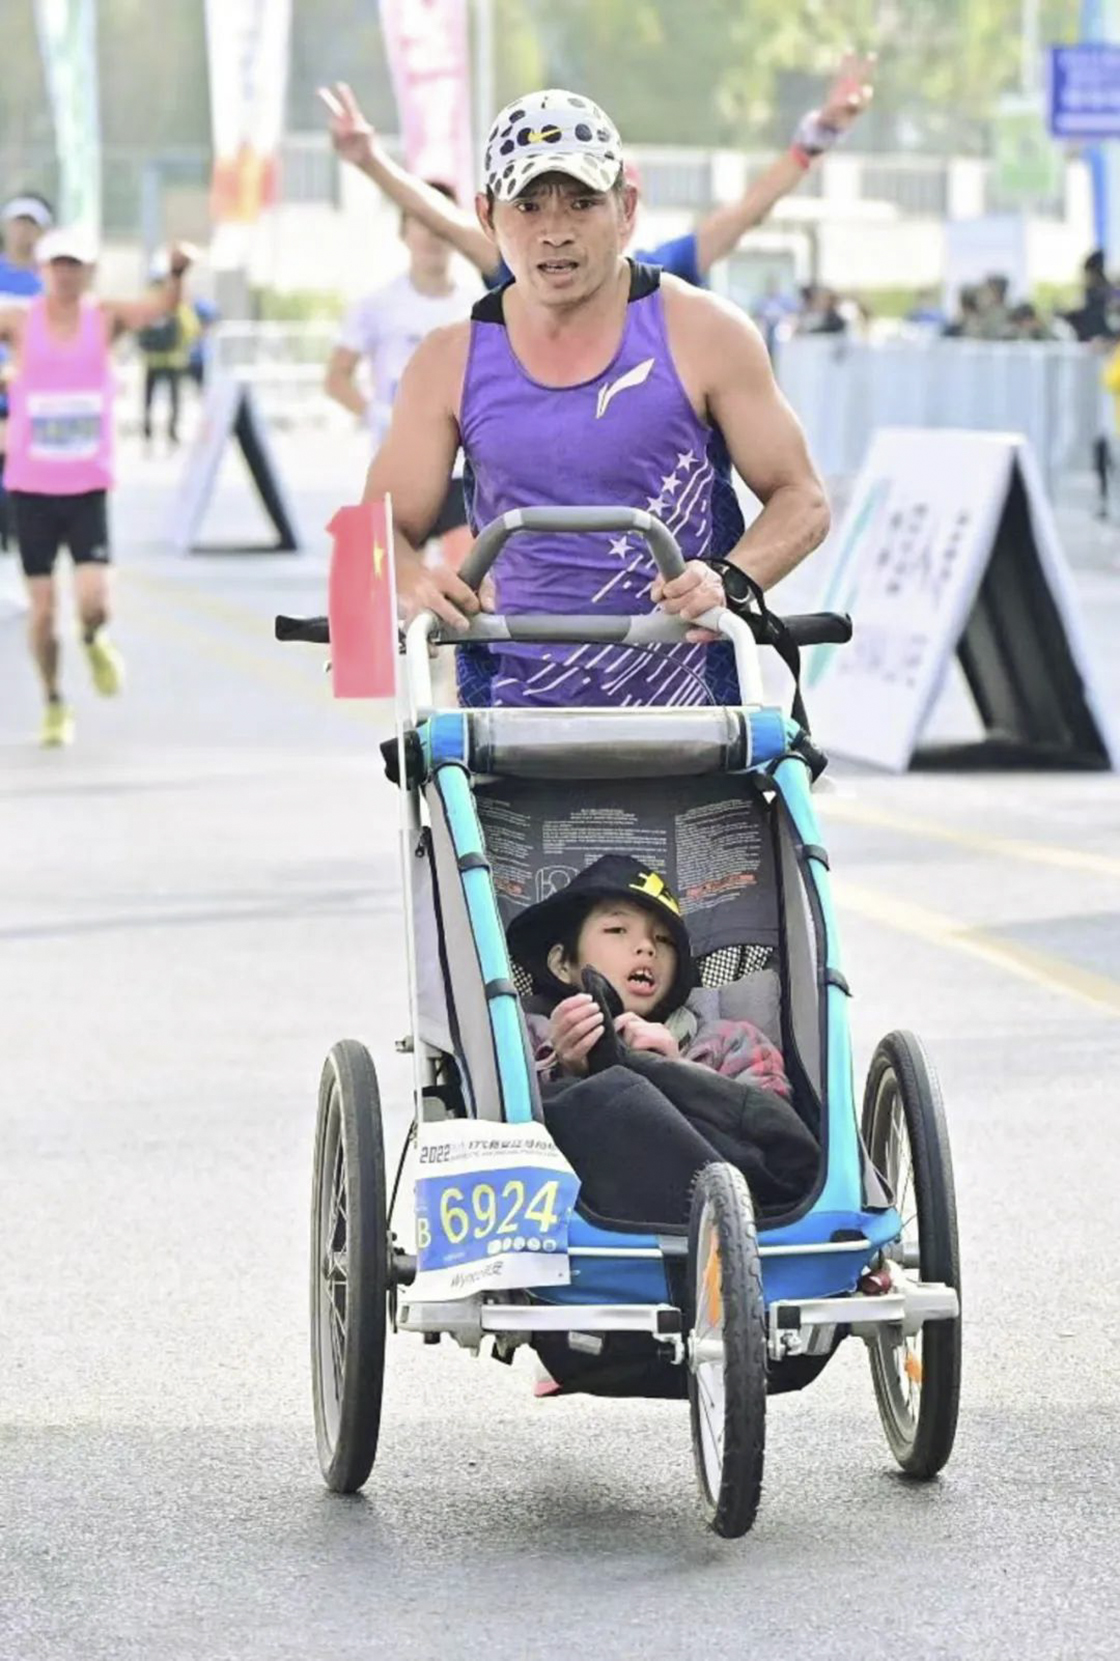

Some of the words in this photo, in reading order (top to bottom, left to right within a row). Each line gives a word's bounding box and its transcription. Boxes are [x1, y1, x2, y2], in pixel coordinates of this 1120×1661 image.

[419, 1144, 450, 1163] 2022
[440, 1180, 559, 1243] 6924
[417, 1217, 431, 1249] B
